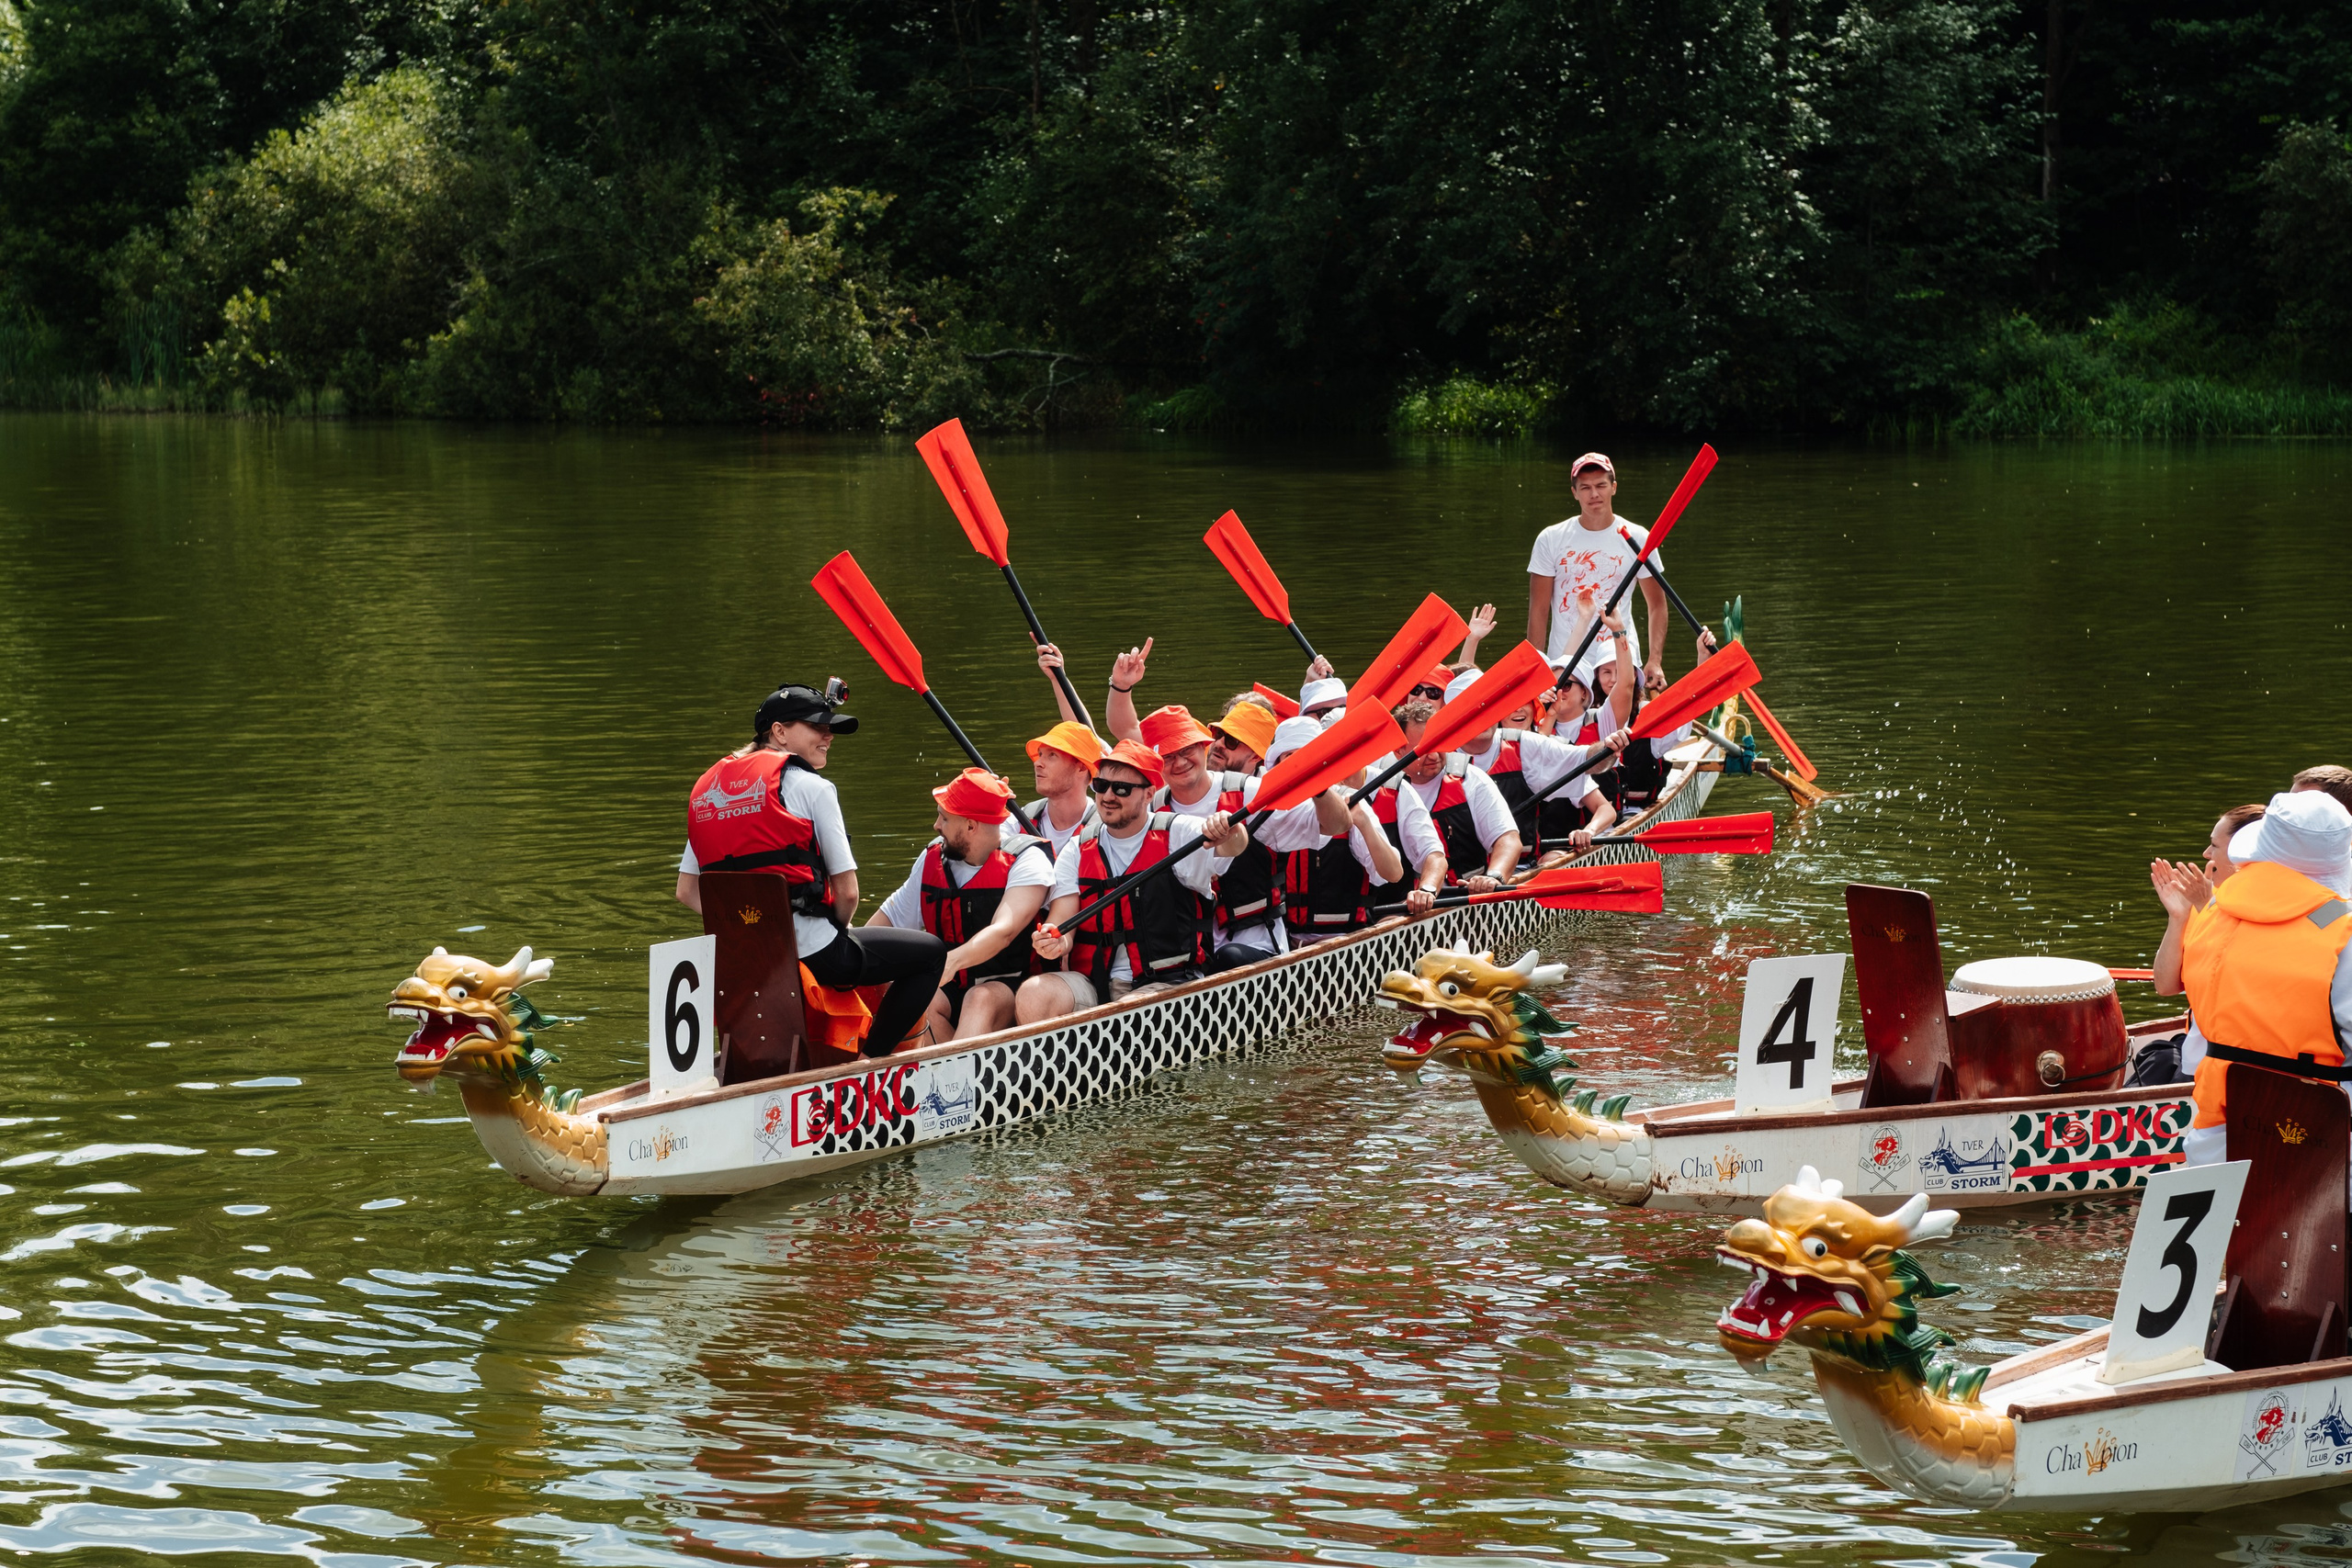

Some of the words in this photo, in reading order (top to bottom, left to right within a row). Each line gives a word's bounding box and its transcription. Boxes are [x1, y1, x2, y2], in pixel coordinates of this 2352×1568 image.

[729, 779, 749, 790] TVER
[697, 811, 712, 820] CLUB
[718, 804, 762, 820] STORM
[665, 960, 700, 1073] 6
[1756, 977, 1816, 1089] 4
[945, 1082, 959, 1094] TVER
[923, 1120, 935, 1128] CLUB
[939, 1113, 971, 1130] STORM
[2091, 1104, 2181, 1145] DKC
[1962, 1140, 1984, 1151] TVER
[1951, 1176, 2001, 1190] STORM
[2135, 1189, 2216, 1339] 3
[2310, 1452, 2328, 1462] CLUB
